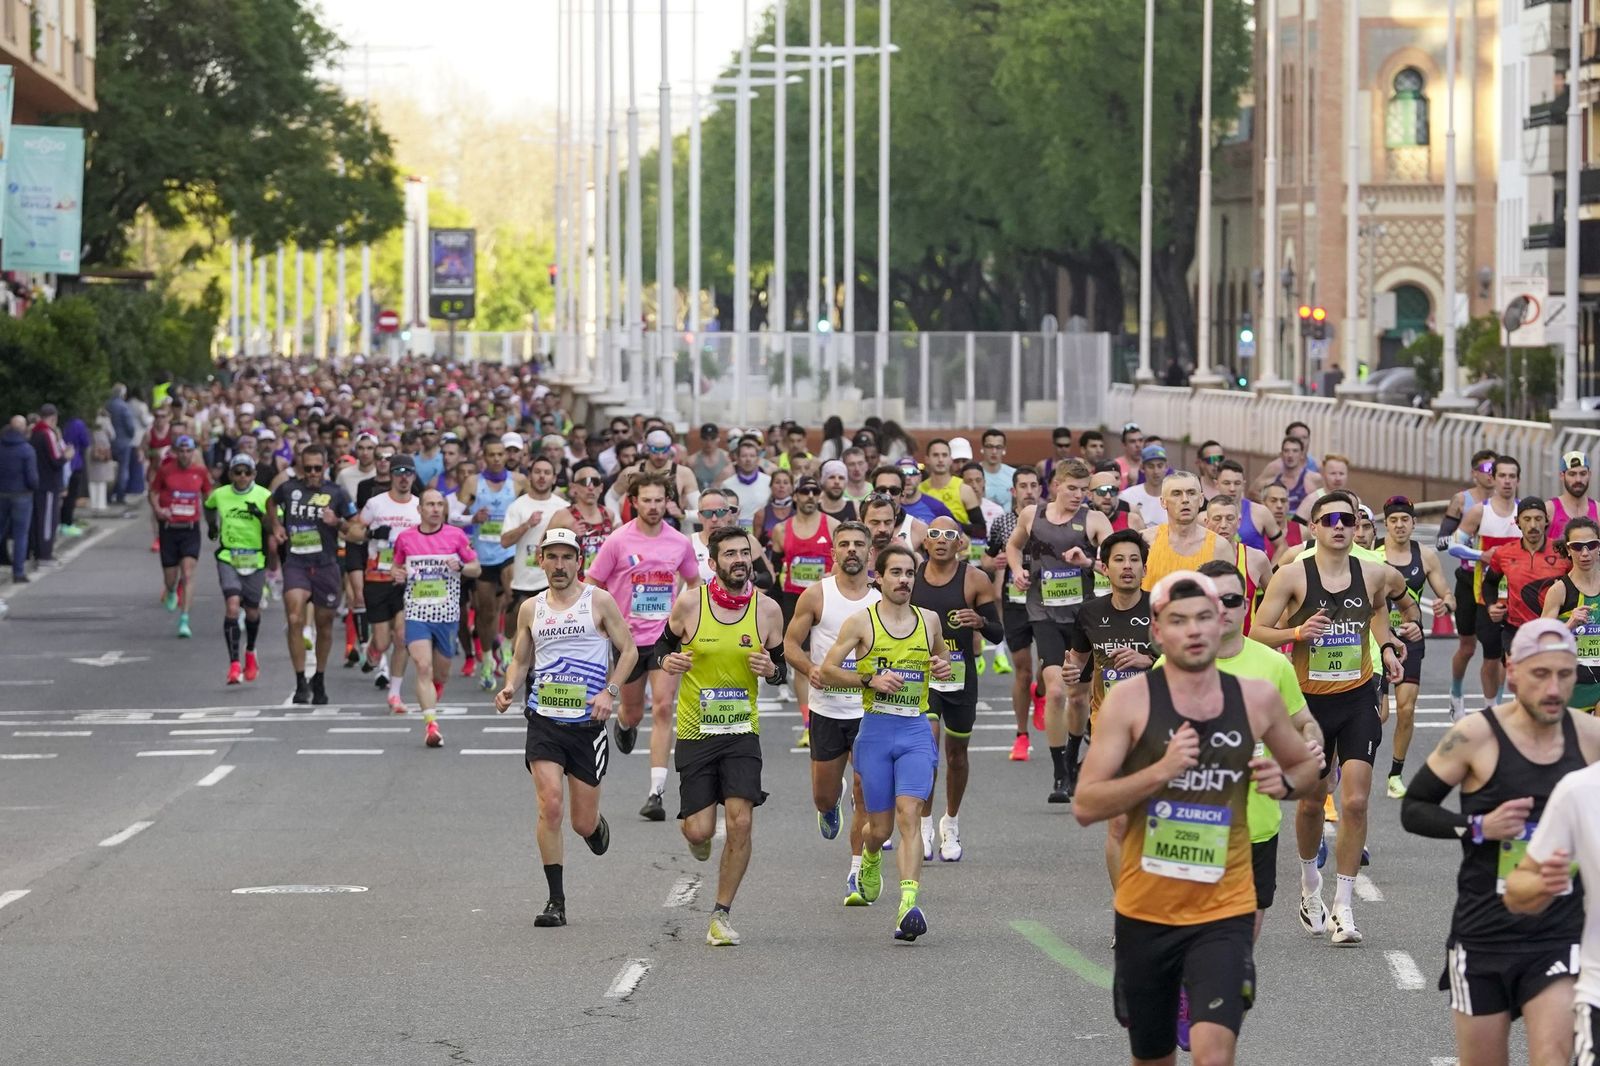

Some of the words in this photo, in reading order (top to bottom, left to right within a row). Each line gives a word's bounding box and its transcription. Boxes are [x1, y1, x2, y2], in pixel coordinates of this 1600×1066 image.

[1047, 588, 1078, 597] THOMAS
[636, 603, 666, 611] ETIENNE
[538, 625, 586, 637] MARACENA
[1327, 636, 1355, 644] ZURICH
[1328, 660, 1342, 670] AD
[554, 674, 584, 683] ZURICH
[717, 690, 745, 698] ZURICH
[541, 696, 582, 708] ROBERTO
[718, 704, 735, 712] 2033
[700, 714, 726, 724] JOAO
[728, 713, 752, 724] CRUZ
[1175, 807, 1223, 822] ZURICH
[1174, 829, 1201, 842] 2269
[1155, 842, 1216, 863] MARTIN
